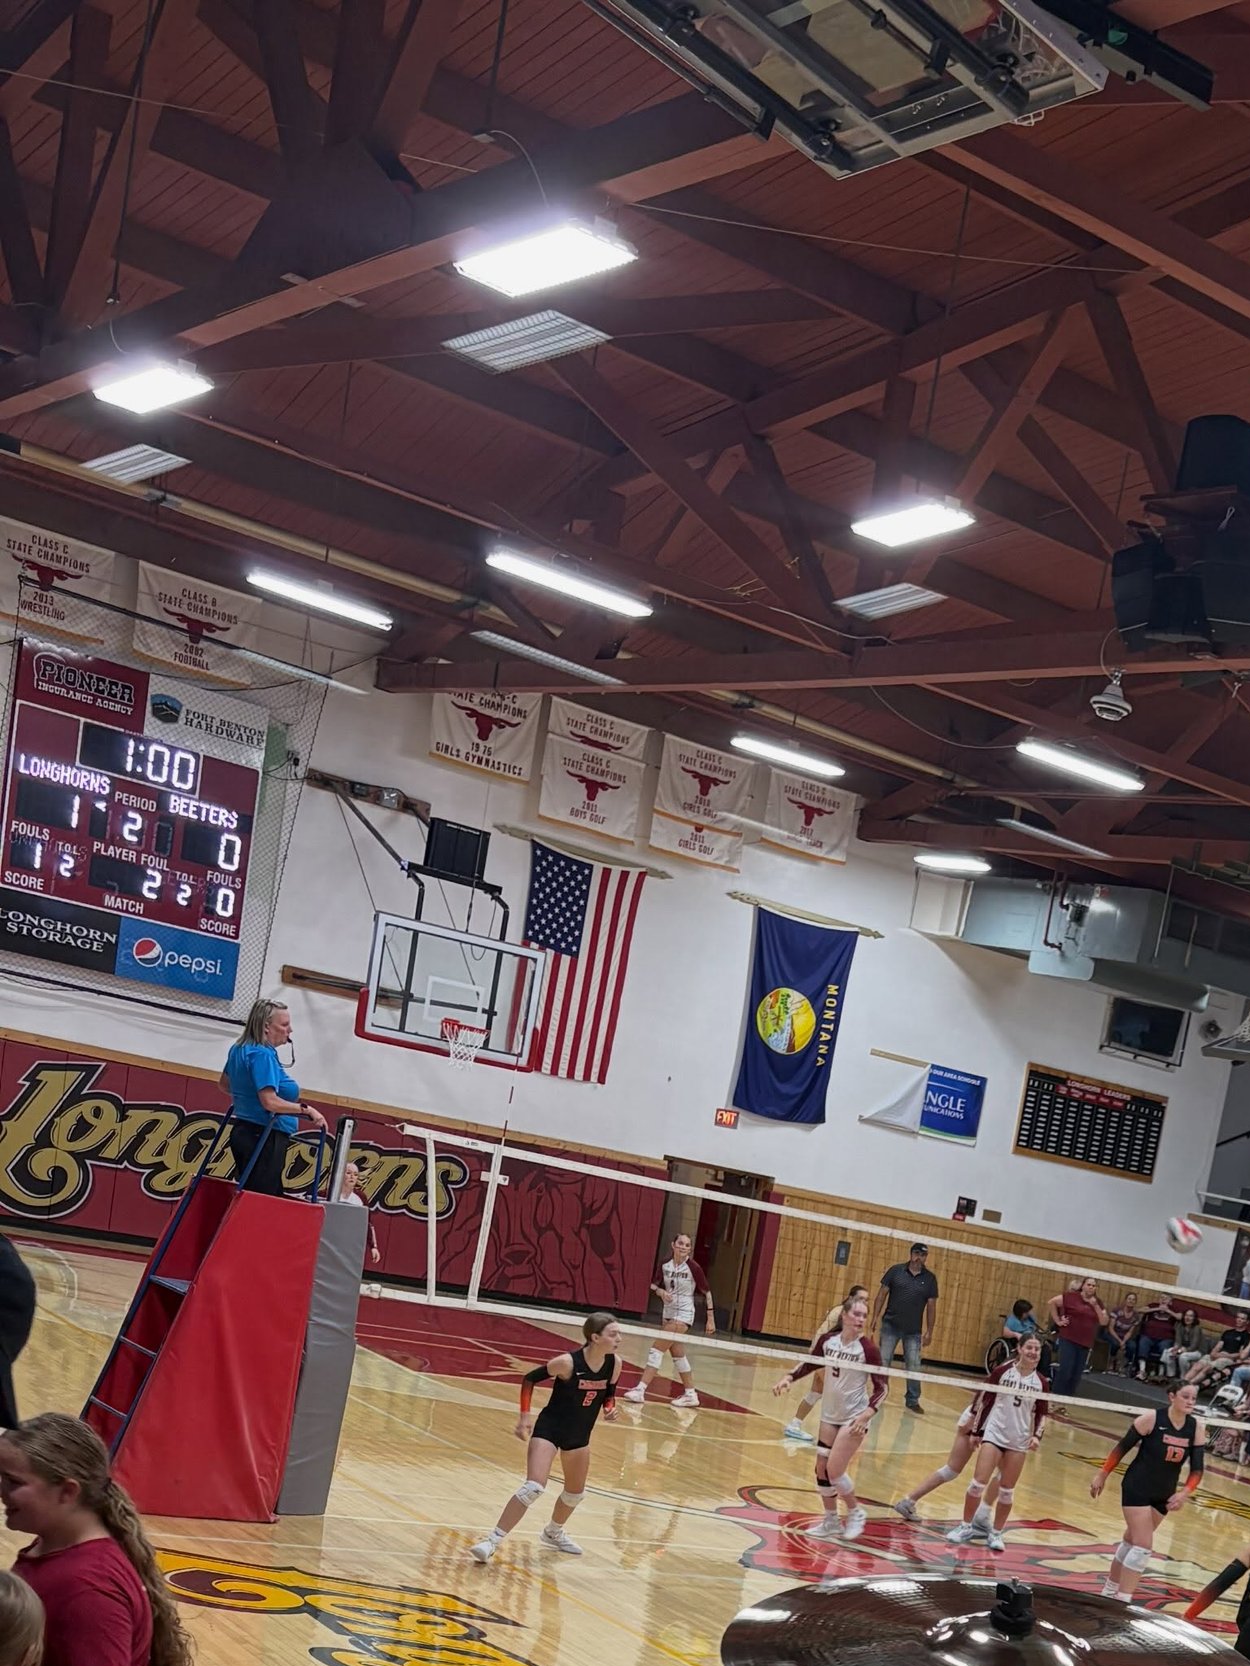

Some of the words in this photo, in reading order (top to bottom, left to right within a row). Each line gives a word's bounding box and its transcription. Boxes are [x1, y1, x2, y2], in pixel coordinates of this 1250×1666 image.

[7, 538, 33, 556] STATE
[37, 548, 91, 574] CHAMPIONS
[31, 534, 59, 551] CLASS
[62, 545, 69, 554] C
[33, 591, 54, 606] 2013
[158, 591, 182, 609] STATE
[187, 601, 238, 625] CHAMPIONS
[181, 588, 208, 605] CLASS
[20, 600, 65, 621] WRESTLING
[173, 651, 211, 671] FOOTBALL
[40, 659, 135, 705] PIONEER
[95, 697, 134, 716] AGENCY
[479, 697, 528, 719] CHAMPIONS
[183, 717, 265, 747] HARDWARE
[185, 708, 217, 727] FORT
[218, 717, 265, 739] BENTON
[566, 717, 588, 733] STATE
[589, 724, 630, 746] CHAMPIONS
[586, 713, 608, 728] CLASS
[125, 738, 196, 790] 1:00
[435, 741, 461, 758] GIRLS
[464, 752, 523, 777] GYMNASTICS
[582, 752, 604, 767] CLASS
[678, 753, 698, 767] STATE
[699, 760, 737, 779] CHAMPIONS
[696, 749, 717, 763] CLASS
[19, 753, 111, 795] LONGHORNS
[563, 756, 584, 772] STATE
[585, 764, 627, 784] CHAMPIONS
[114, 791, 157, 812] PERIOD
[784, 784, 802, 799] STATE
[804, 791, 841, 810] CHAMPIONS
[71, 795, 80, 829] 1
[169, 795, 239, 829] BEETERS
[569, 807, 588, 820] BOYS
[588, 812, 607, 825] GOLF
[682, 801, 702, 815] GIRLS
[703, 808, 718, 820] GOLF
[11, 820, 50, 841] FOULS
[122, 811, 143, 842] 2
[34, 842, 42, 869] 1
[93, 841, 136, 863] PLAYER
[141, 853, 170, 872] FOUL
[217, 833, 242, 872] 0
[678, 838, 697, 851] GIRLS
[698, 845, 714, 857] GOLF
[59, 854, 75, 878] 2
[4, 871, 44, 891] SCORE
[142, 868, 162, 900] 2
[206, 869, 242, 889] FOULS
[104, 894, 144, 914] MATCH
[176, 884, 192, 906] 2
[216, 887, 235, 918] 0
[0, 908, 117, 945] LONGHORN
[6, 921, 104, 953] STORAGE
[200, 918, 236, 937] SCORE
[164, 951, 222, 976] pepsi
[815, 984, 839, 1066] MONTANA
[944, 1072, 956, 1080] AREA
[957, 1075, 981, 1086] SCHOOLS
[1067, 1079, 1101, 1093] LONGHORN
[1103, 1088, 1131, 1101] LEADERS
[717, 1111, 736, 1125] EXIT
[1013, 1395, 1022, 1407] 5
